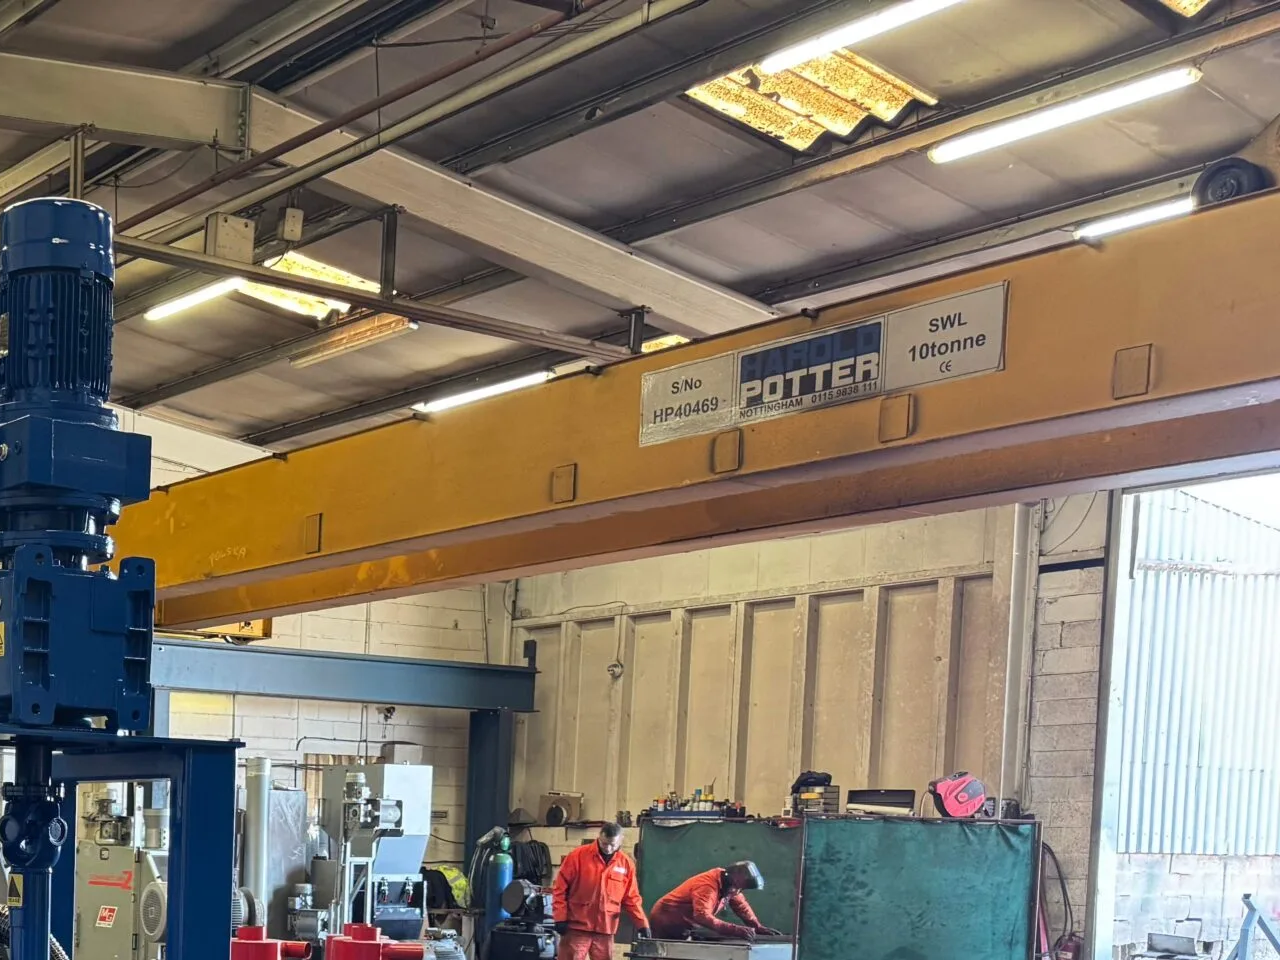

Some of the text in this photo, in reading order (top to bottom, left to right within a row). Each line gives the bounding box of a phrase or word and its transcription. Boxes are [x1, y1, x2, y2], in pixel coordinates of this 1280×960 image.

[928, 312, 968, 333] SWL
[908, 332, 987, 363] 10tonne
[671, 376, 703, 395] S/No
[740, 352, 880, 409] POTTER
[652, 397, 719, 425] HP40469
[739, 381, 878, 419] NOTTINGHAM 0115 9838 111
